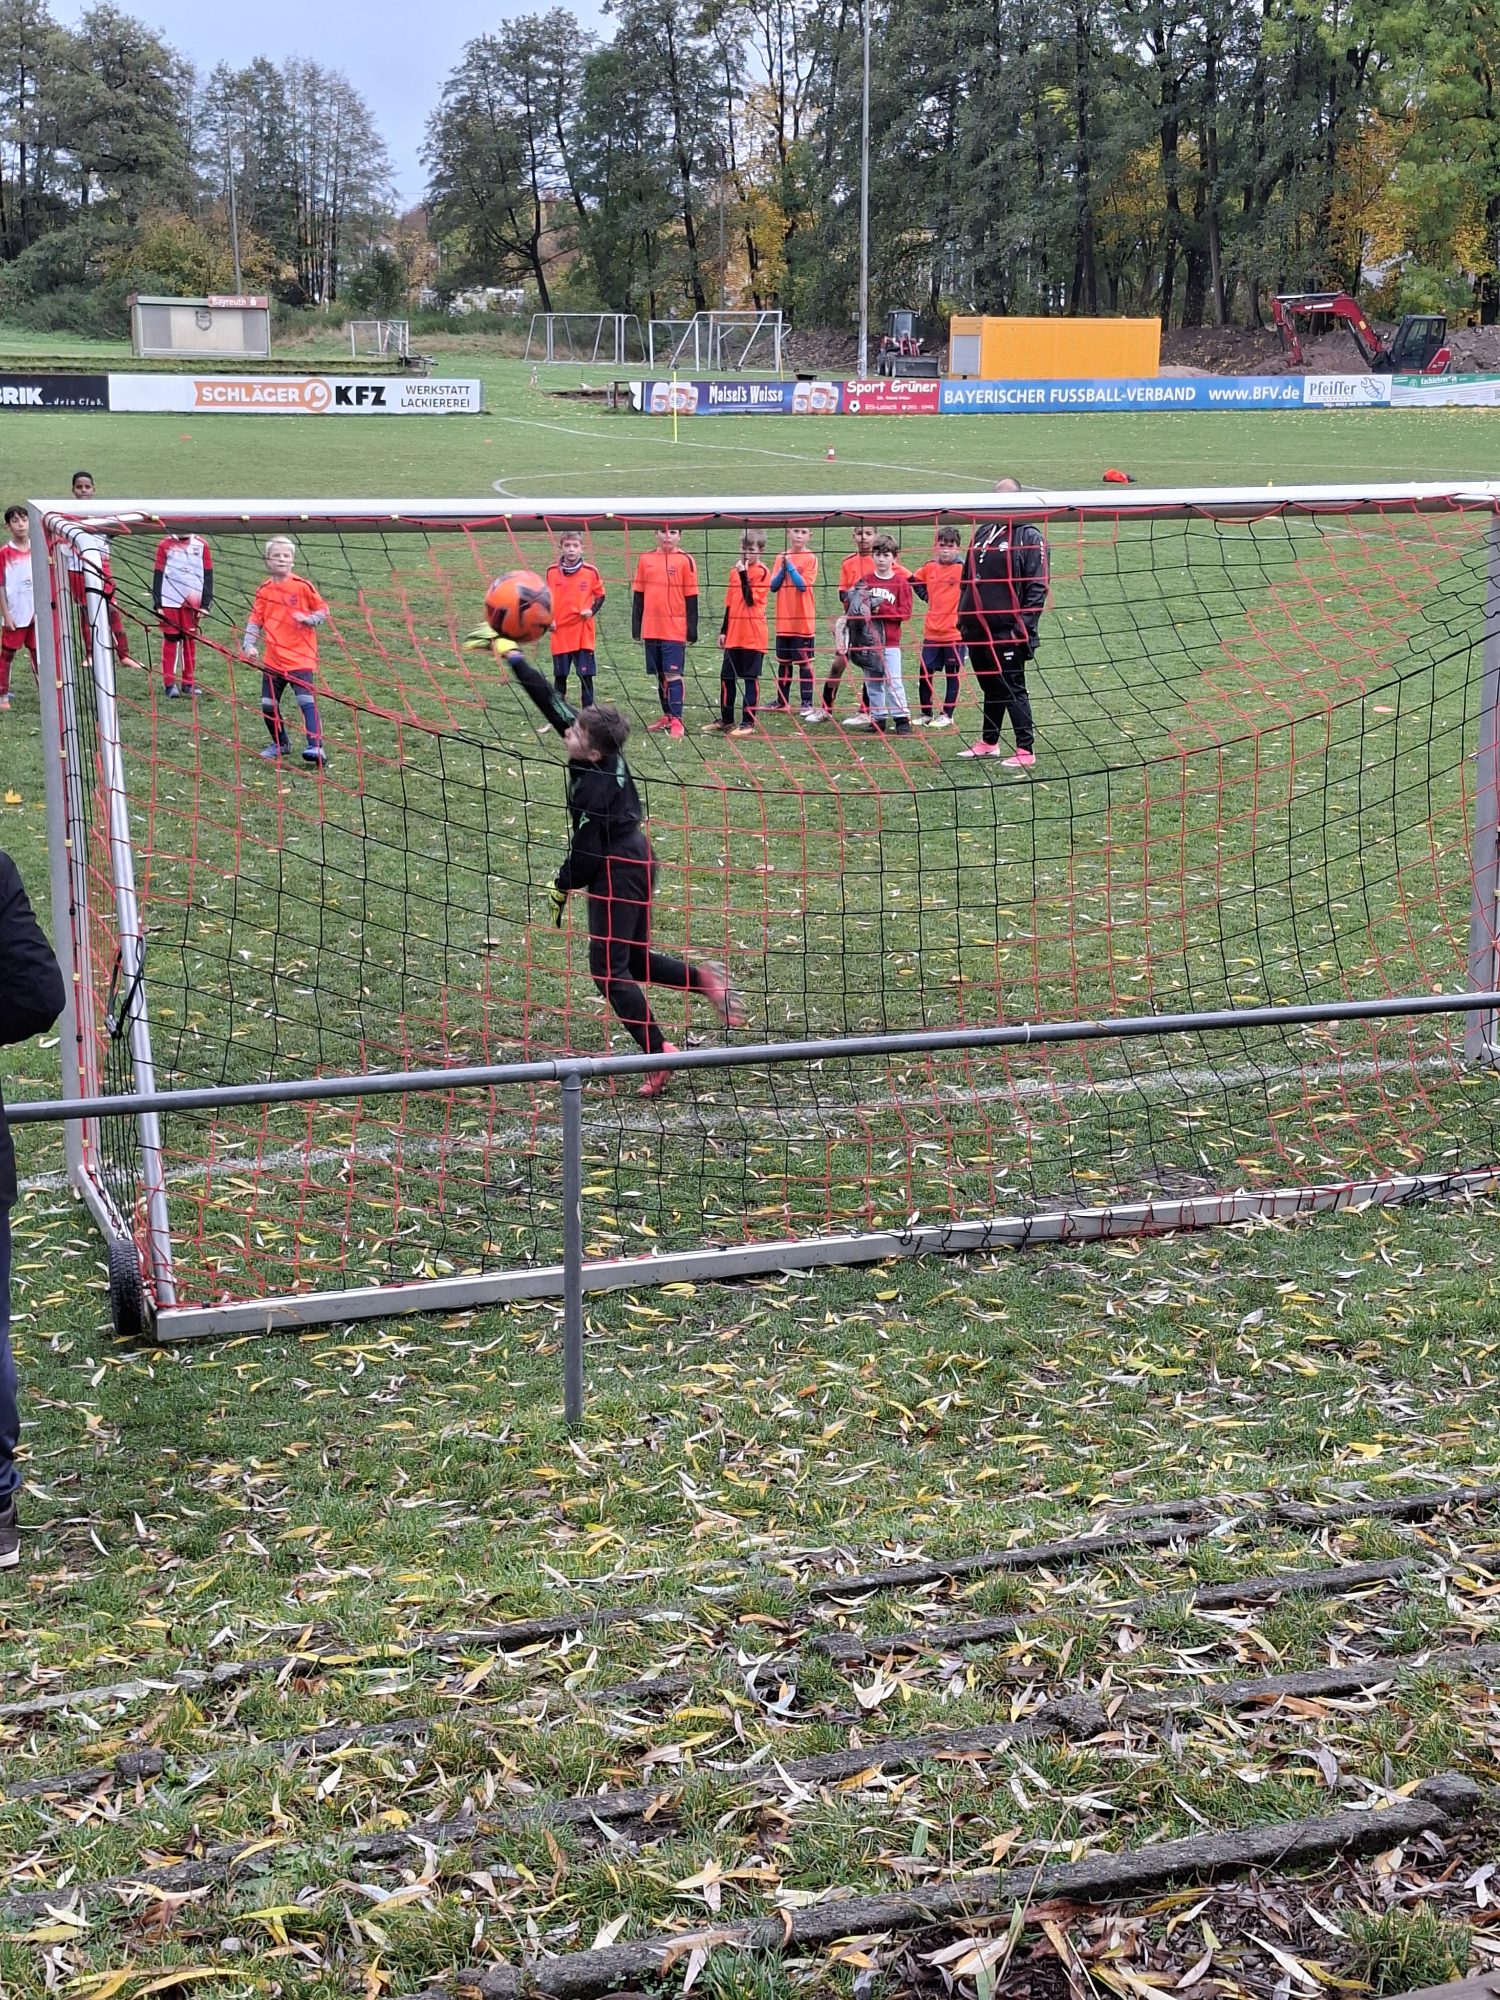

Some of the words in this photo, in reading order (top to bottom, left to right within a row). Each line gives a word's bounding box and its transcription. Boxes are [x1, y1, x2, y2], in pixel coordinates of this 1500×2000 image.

[212, 297, 247, 307] Bayreuth
[0, 386, 43, 405] RIK
[202, 384, 301, 403] SCHLÄGER
[335, 385, 387, 406] KFZ
[405, 385, 470, 395] WERKSTATT
[709, 383, 747, 404] Maisel's
[846, 381, 886, 397] Sport
[891, 380, 938, 393] Grüner
[944, 389, 1046, 404] BAYERISCHER
[1050, 387, 1196, 403] FUSSBALL-VERBAND
[1208, 385, 1300, 401] www.BFV.de
[1309, 381, 1358, 396] Pfeiffer
[400, 398, 470, 408] LACKIEREREI
